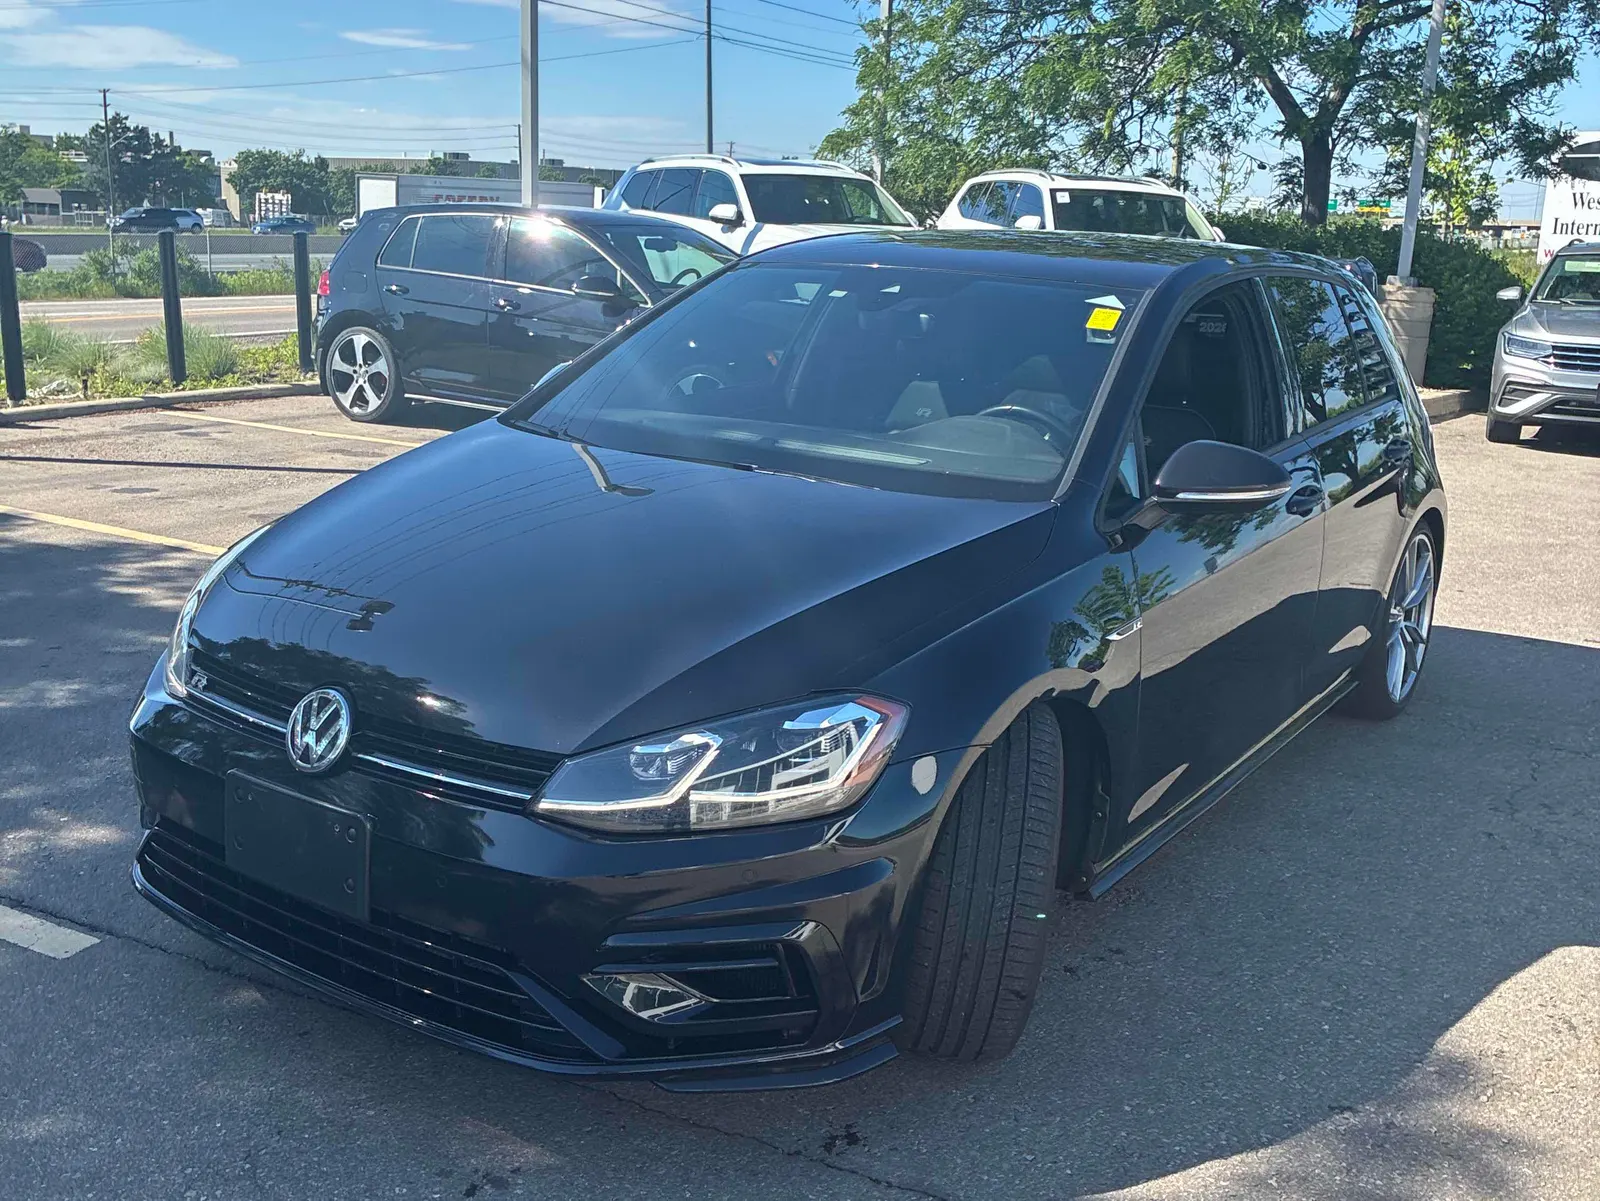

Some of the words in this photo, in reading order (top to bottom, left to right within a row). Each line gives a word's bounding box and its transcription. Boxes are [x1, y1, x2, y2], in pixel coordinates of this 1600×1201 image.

[1572, 192, 1600, 210] Wes
[1552, 217, 1600, 236] Intern
[191, 672, 208, 691] R
[288, 690, 349, 771] VW
